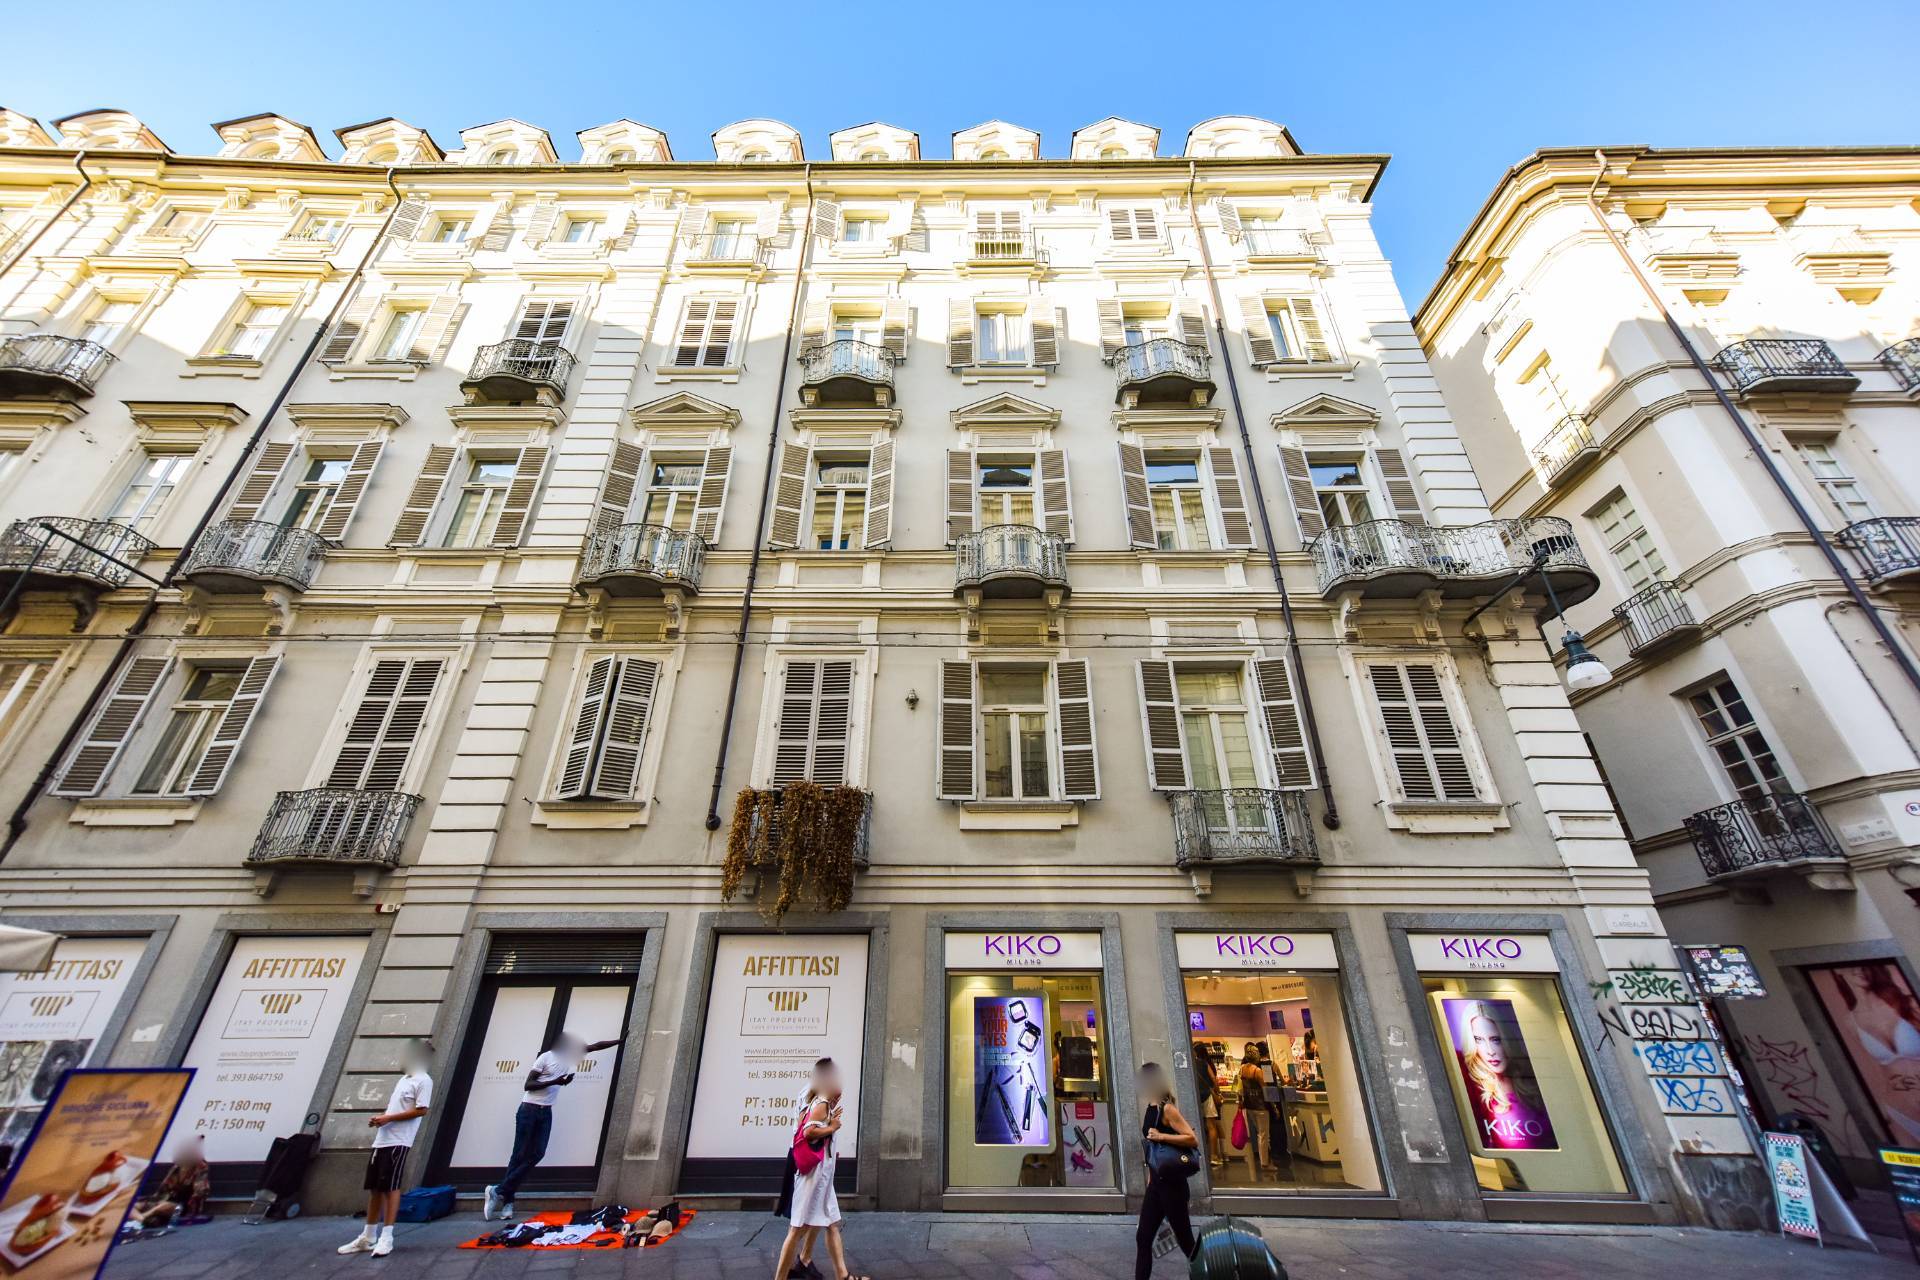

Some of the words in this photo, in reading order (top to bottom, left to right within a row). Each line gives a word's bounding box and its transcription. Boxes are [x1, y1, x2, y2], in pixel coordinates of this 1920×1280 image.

[985, 935, 1062, 955] KIKO
[1216, 935, 1295, 955] KIKO
[1440, 938, 1522, 959] KIKO
[242, 958, 347, 979] AFFITTASI
[743, 956, 840, 976] AFFITTASI
[744, 1048, 821, 1056] www.itayproperties.com
[231, 1073, 246, 1081] 393
[247, 1072, 284, 1081] 8647150
[748, 1070, 760, 1078] tel.
[762, 1070, 777, 1078] 393
[229, 1100, 251, 1111] 180
[252, 1102, 272, 1113] mq
[768, 1097, 789, 1108] 180
[195, 1118, 220, 1130] P-1:
[222, 1118, 244, 1129] 150
[245, 1120, 266, 1132] mq
[741, 1115, 764, 1126] P-1:
[767, 1115, 788, 1126] 150
[1483, 1119, 1543, 1136] KIKO
